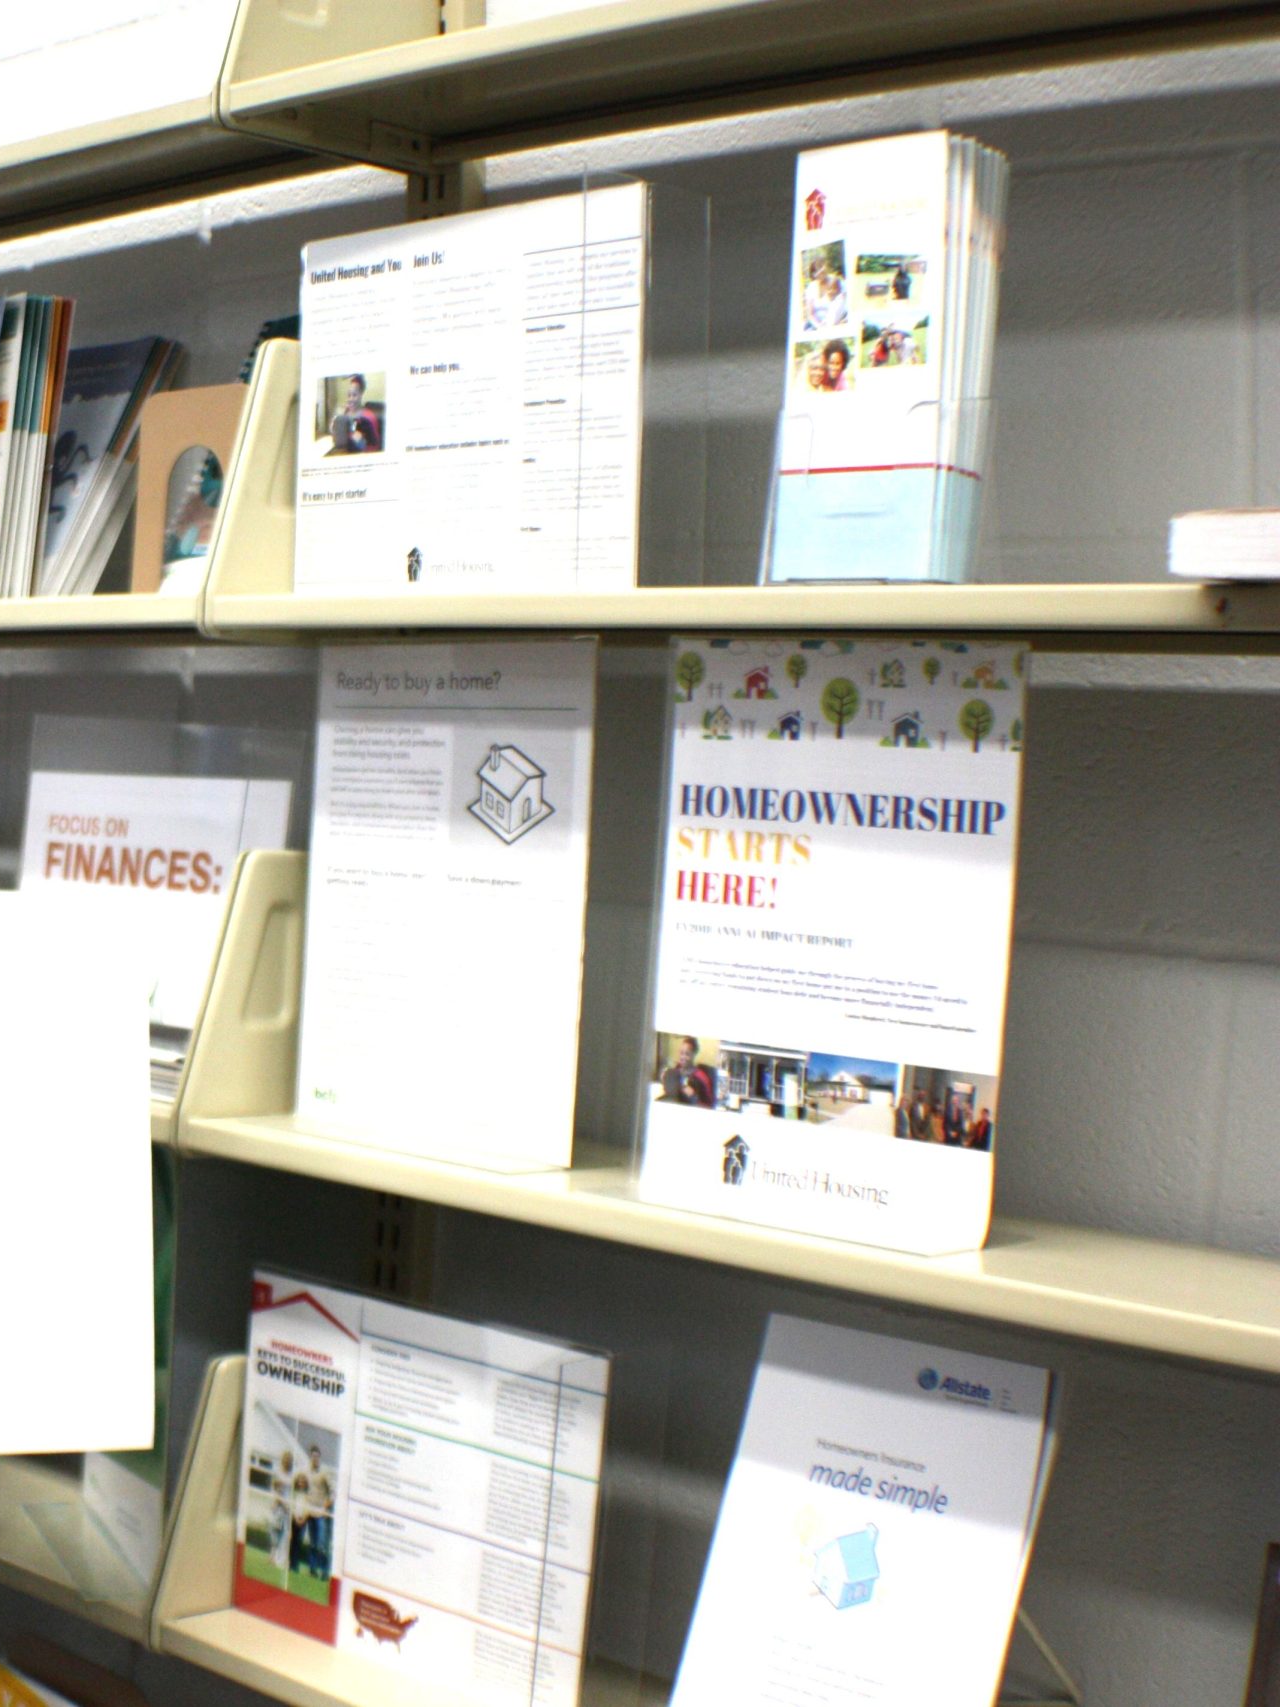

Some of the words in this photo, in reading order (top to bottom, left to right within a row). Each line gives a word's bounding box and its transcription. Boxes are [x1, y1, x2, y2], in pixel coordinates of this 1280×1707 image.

[310, 268, 336, 285] United
[337, 264, 369, 280] Housing
[370, 260, 386, 274] and
[387, 259, 403, 272] You
[413, 254, 429, 268] Join
[410, 364, 419, 375] We
[420, 365, 432, 375] can
[433, 362, 447, 375] help
[336, 671, 382, 697] Ready
[384, 674, 401, 691] to
[404, 672, 432, 696] buy
[436, 678, 445, 691] a
[449, 671, 502, 691] home?
[679, 783, 1006, 836] HOMEOWNERSHIP
[47, 814, 101, 836] FOCUS
[104, 816, 130, 837] ON
[676, 827, 813, 865] STARTS
[43, 841, 223, 894] FINANCES:
[676, 870, 778, 909] HERE!
[760, 929, 805, 944] IMPACT
[807, 933, 855, 949] REPORT
[752, 1160, 809, 1190] United
[812, 1171, 890, 1209] Housing
[256, 1360, 345, 1398] OWNERSHIP
[257, 1348, 279, 1362] KEYS
[280, 1354, 292, 1366] TO
[293, 1357, 345, 1381] SUCCESSFUL
[939, 1376, 992, 1400] Allstate
[880, 1451, 926, 1473] Insurance
[809, 1464, 873, 1496] made
[874, 1476, 949, 1514] simple
